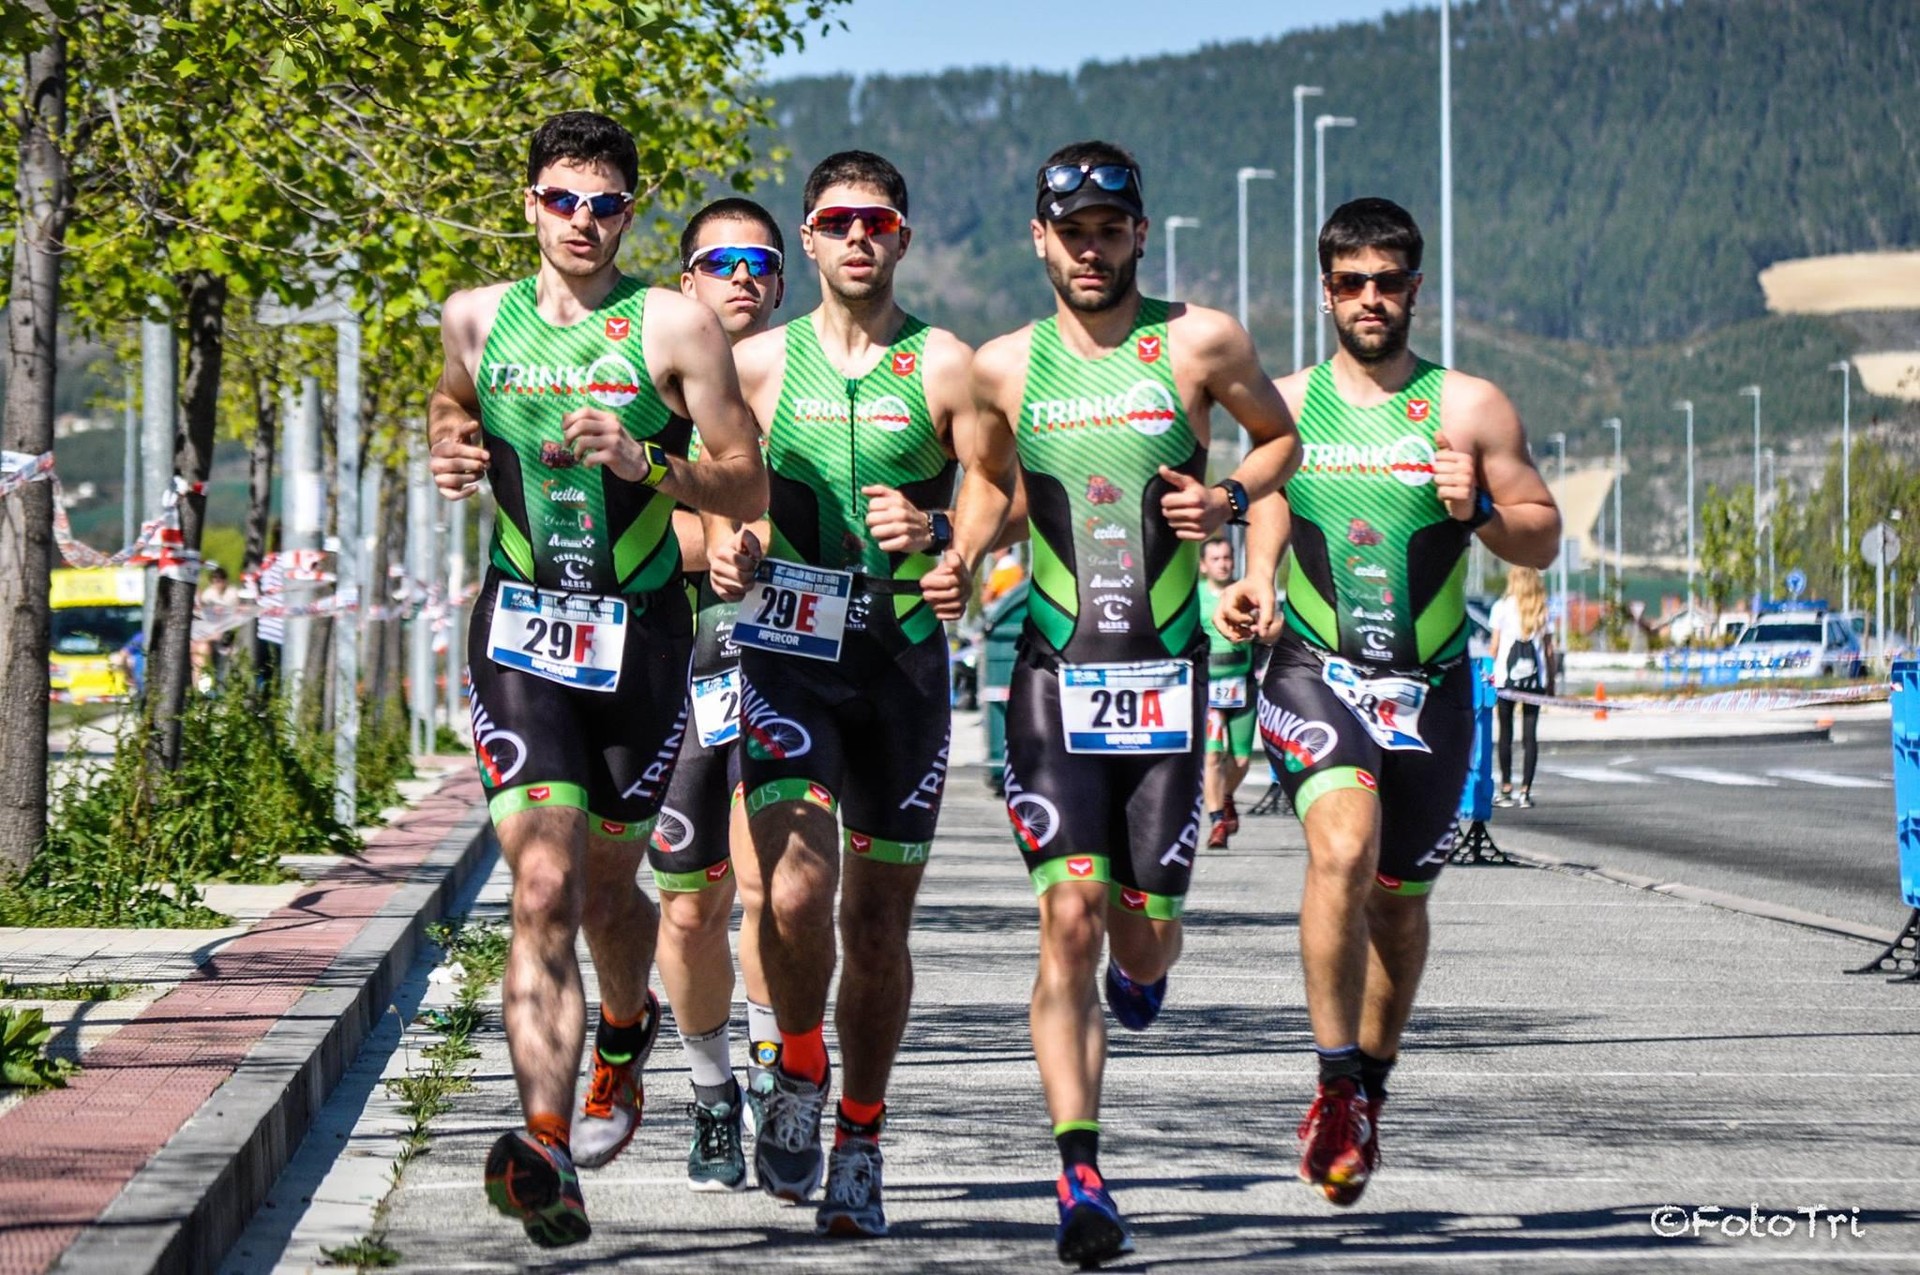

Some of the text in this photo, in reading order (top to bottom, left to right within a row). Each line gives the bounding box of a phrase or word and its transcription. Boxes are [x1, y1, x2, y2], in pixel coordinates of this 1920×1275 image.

[755, 586, 819, 633] 29E
[522, 617, 595, 664] 29F
[758, 629, 800, 647] HIPERCOR
[1090, 689, 1164, 728] 29A
